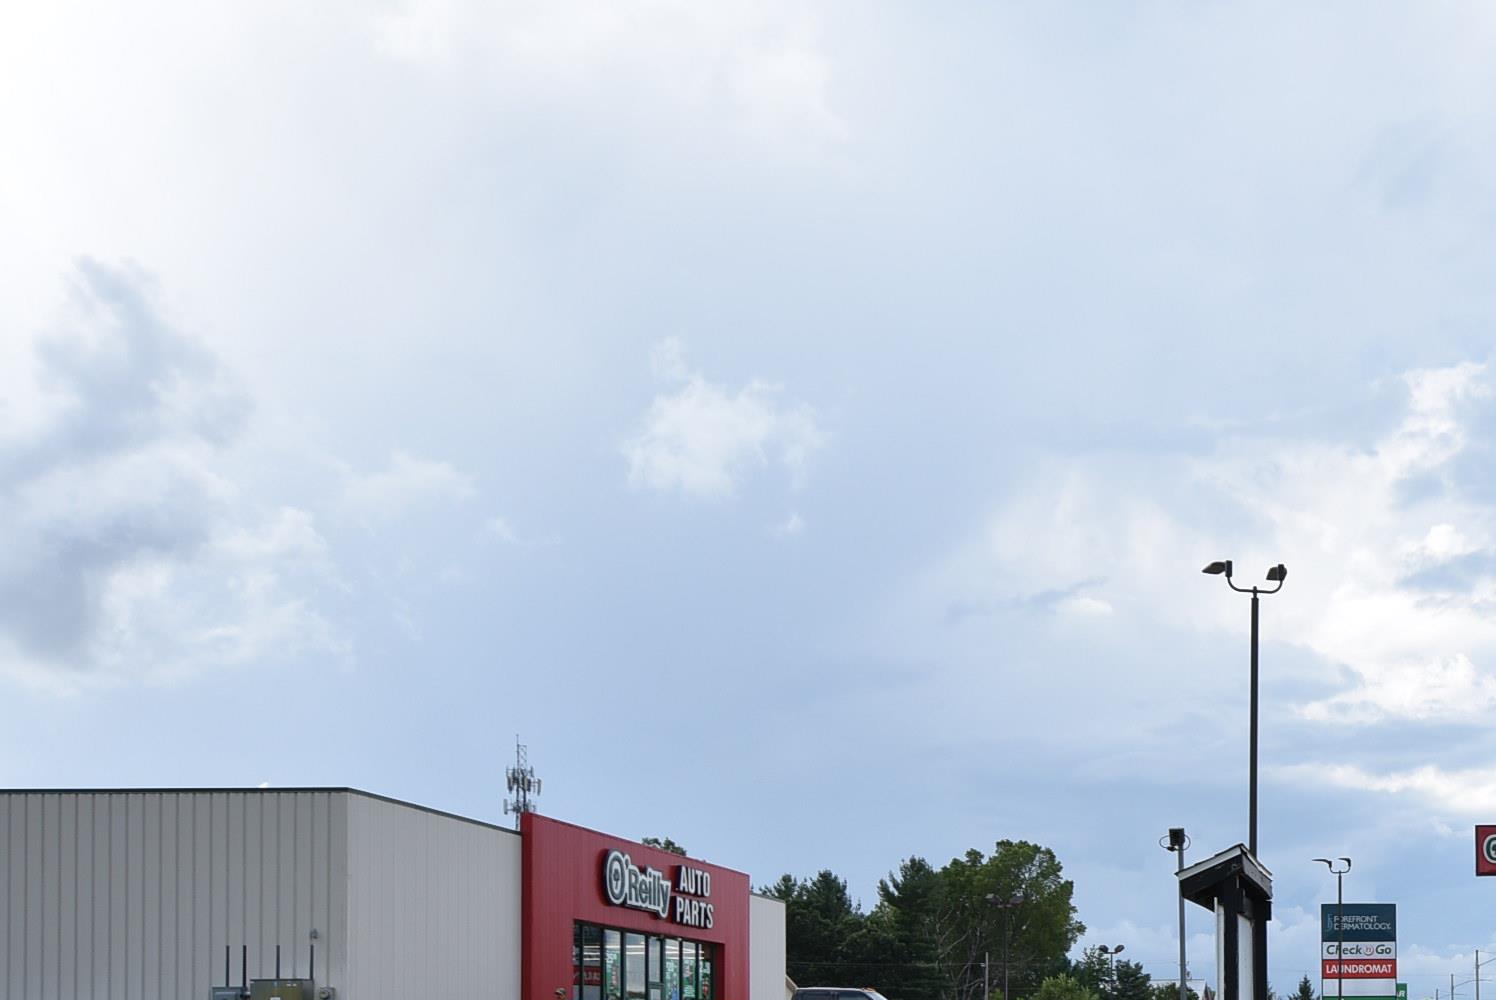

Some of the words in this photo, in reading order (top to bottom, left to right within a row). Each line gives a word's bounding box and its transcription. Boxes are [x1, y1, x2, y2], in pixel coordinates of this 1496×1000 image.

[606, 850, 672, 919] O'Reilly
[679, 866, 711, 897] AUTO
[676, 897, 714, 929] PARTS
[1375, 944, 1392, 955] Go
